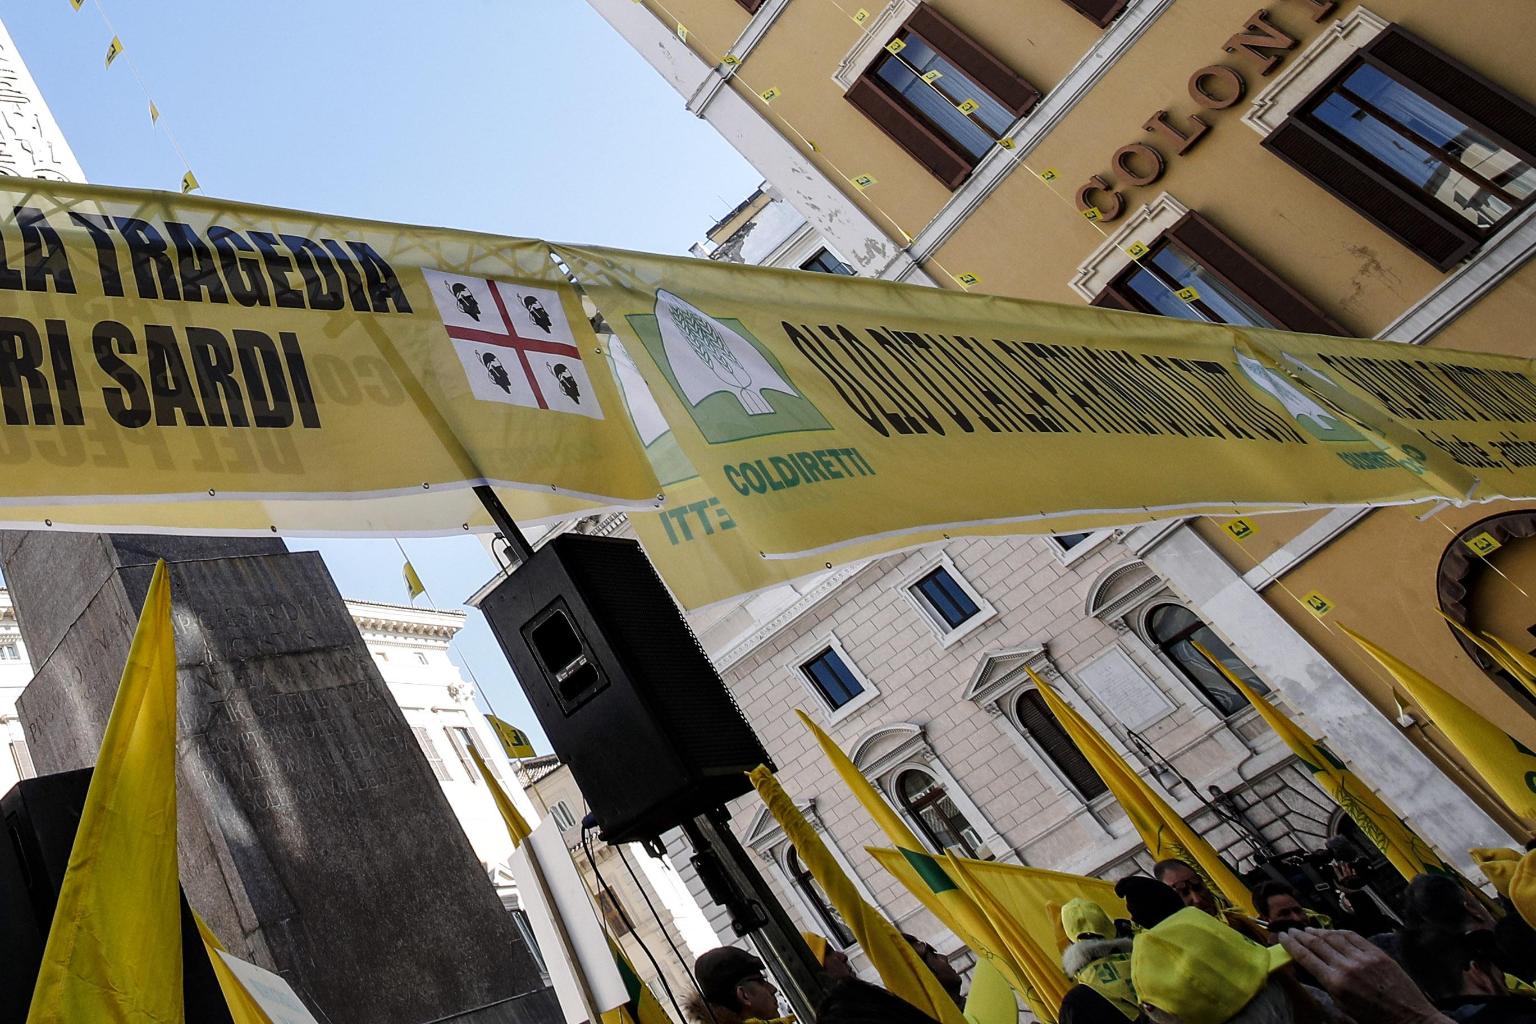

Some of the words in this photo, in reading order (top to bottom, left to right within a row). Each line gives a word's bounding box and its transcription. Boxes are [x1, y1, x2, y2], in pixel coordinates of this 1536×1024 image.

[67, 210, 413, 314] TRAGEDIA
[91, 320, 321, 429] SARDI
[781, 320, 946, 437] OLIO
[722, 448, 876, 496] COLDIRETTI
